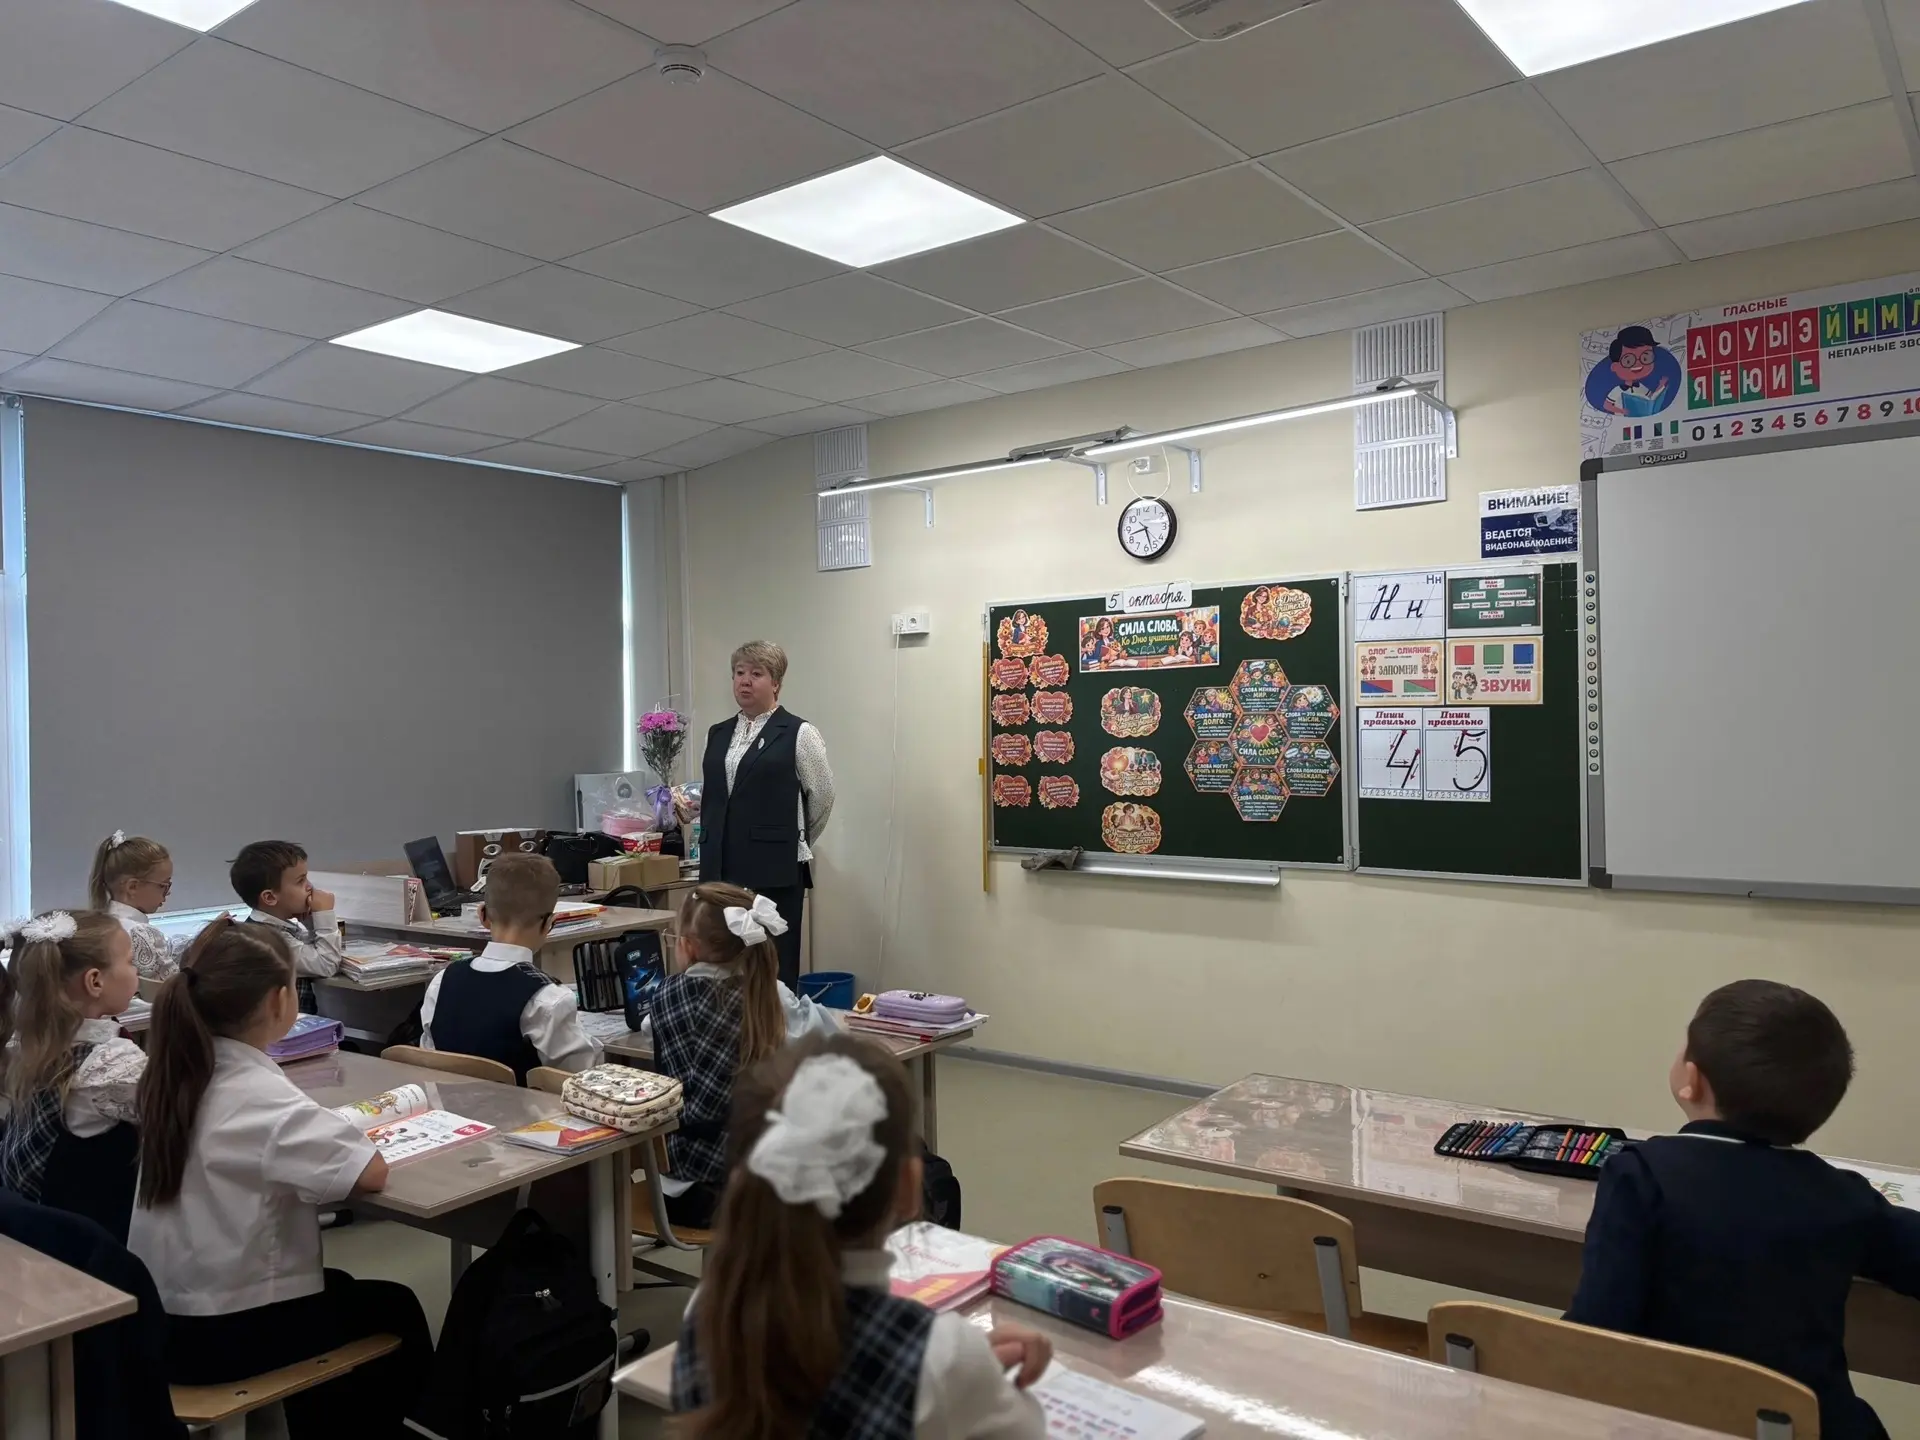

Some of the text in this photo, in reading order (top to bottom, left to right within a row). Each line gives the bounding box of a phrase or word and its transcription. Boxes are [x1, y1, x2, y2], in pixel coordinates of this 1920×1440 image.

[1723, 297, 1788, 317] ГЛАСНЫЕ
[1826, 305, 1840, 339] Й
[1854, 308, 1868, 334] Н
[1881, 303, 1898, 331] М
[1692, 317, 1813, 360] А О У Ы Э
[1828, 341, 1896, 359] НЕПАРНЫЕ
[1693, 359, 1813, 401] Я Ё Ю И Е
[1692, 425, 1705, 441] 0
[1713, 423, 1724, 439] 1
[1730, 420, 1744, 437] 2
[1750, 417, 1764, 433] 3
[1771, 414, 1786, 430] 4
[1793, 411, 1807, 428] 5
[1814, 409, 1829, 425] 6
[1836, 406, 1850, 423] 7
[1857, 403, 1872, 420] 8
[1879, 400, 1894, 417] 9
[1487, 491, 1569, 511] ВНИМАНИЕ!
[1485, 527, 1532, 540] ВЕДЕТСЯ
[1485, 536, 1574, 551] ВИДЕОНАБЛЮДЕНИЕ
[1426, 574, 1442, 584] Нн
[1108, 593, 1120, 609] 5
[1119, 619, 1180, 637] СИЛА СЛОВА.
[1397, 646, 1432, 655] СЛИЯНИЕ
[1480, 678, 1532, 693] ЗВУКИ
[1375, 710, 1404, 719] Пиши
[1440, 710, 1471, 719] Пиши
[1363, 719, 1417, 727] правильно
[1428, 719, 1484, 727] правильно
[1238, 747, 1258, 756] СИЛА
[1386, 729, 1421, 789] 4
[1453, 729, 1488, 791] 5
